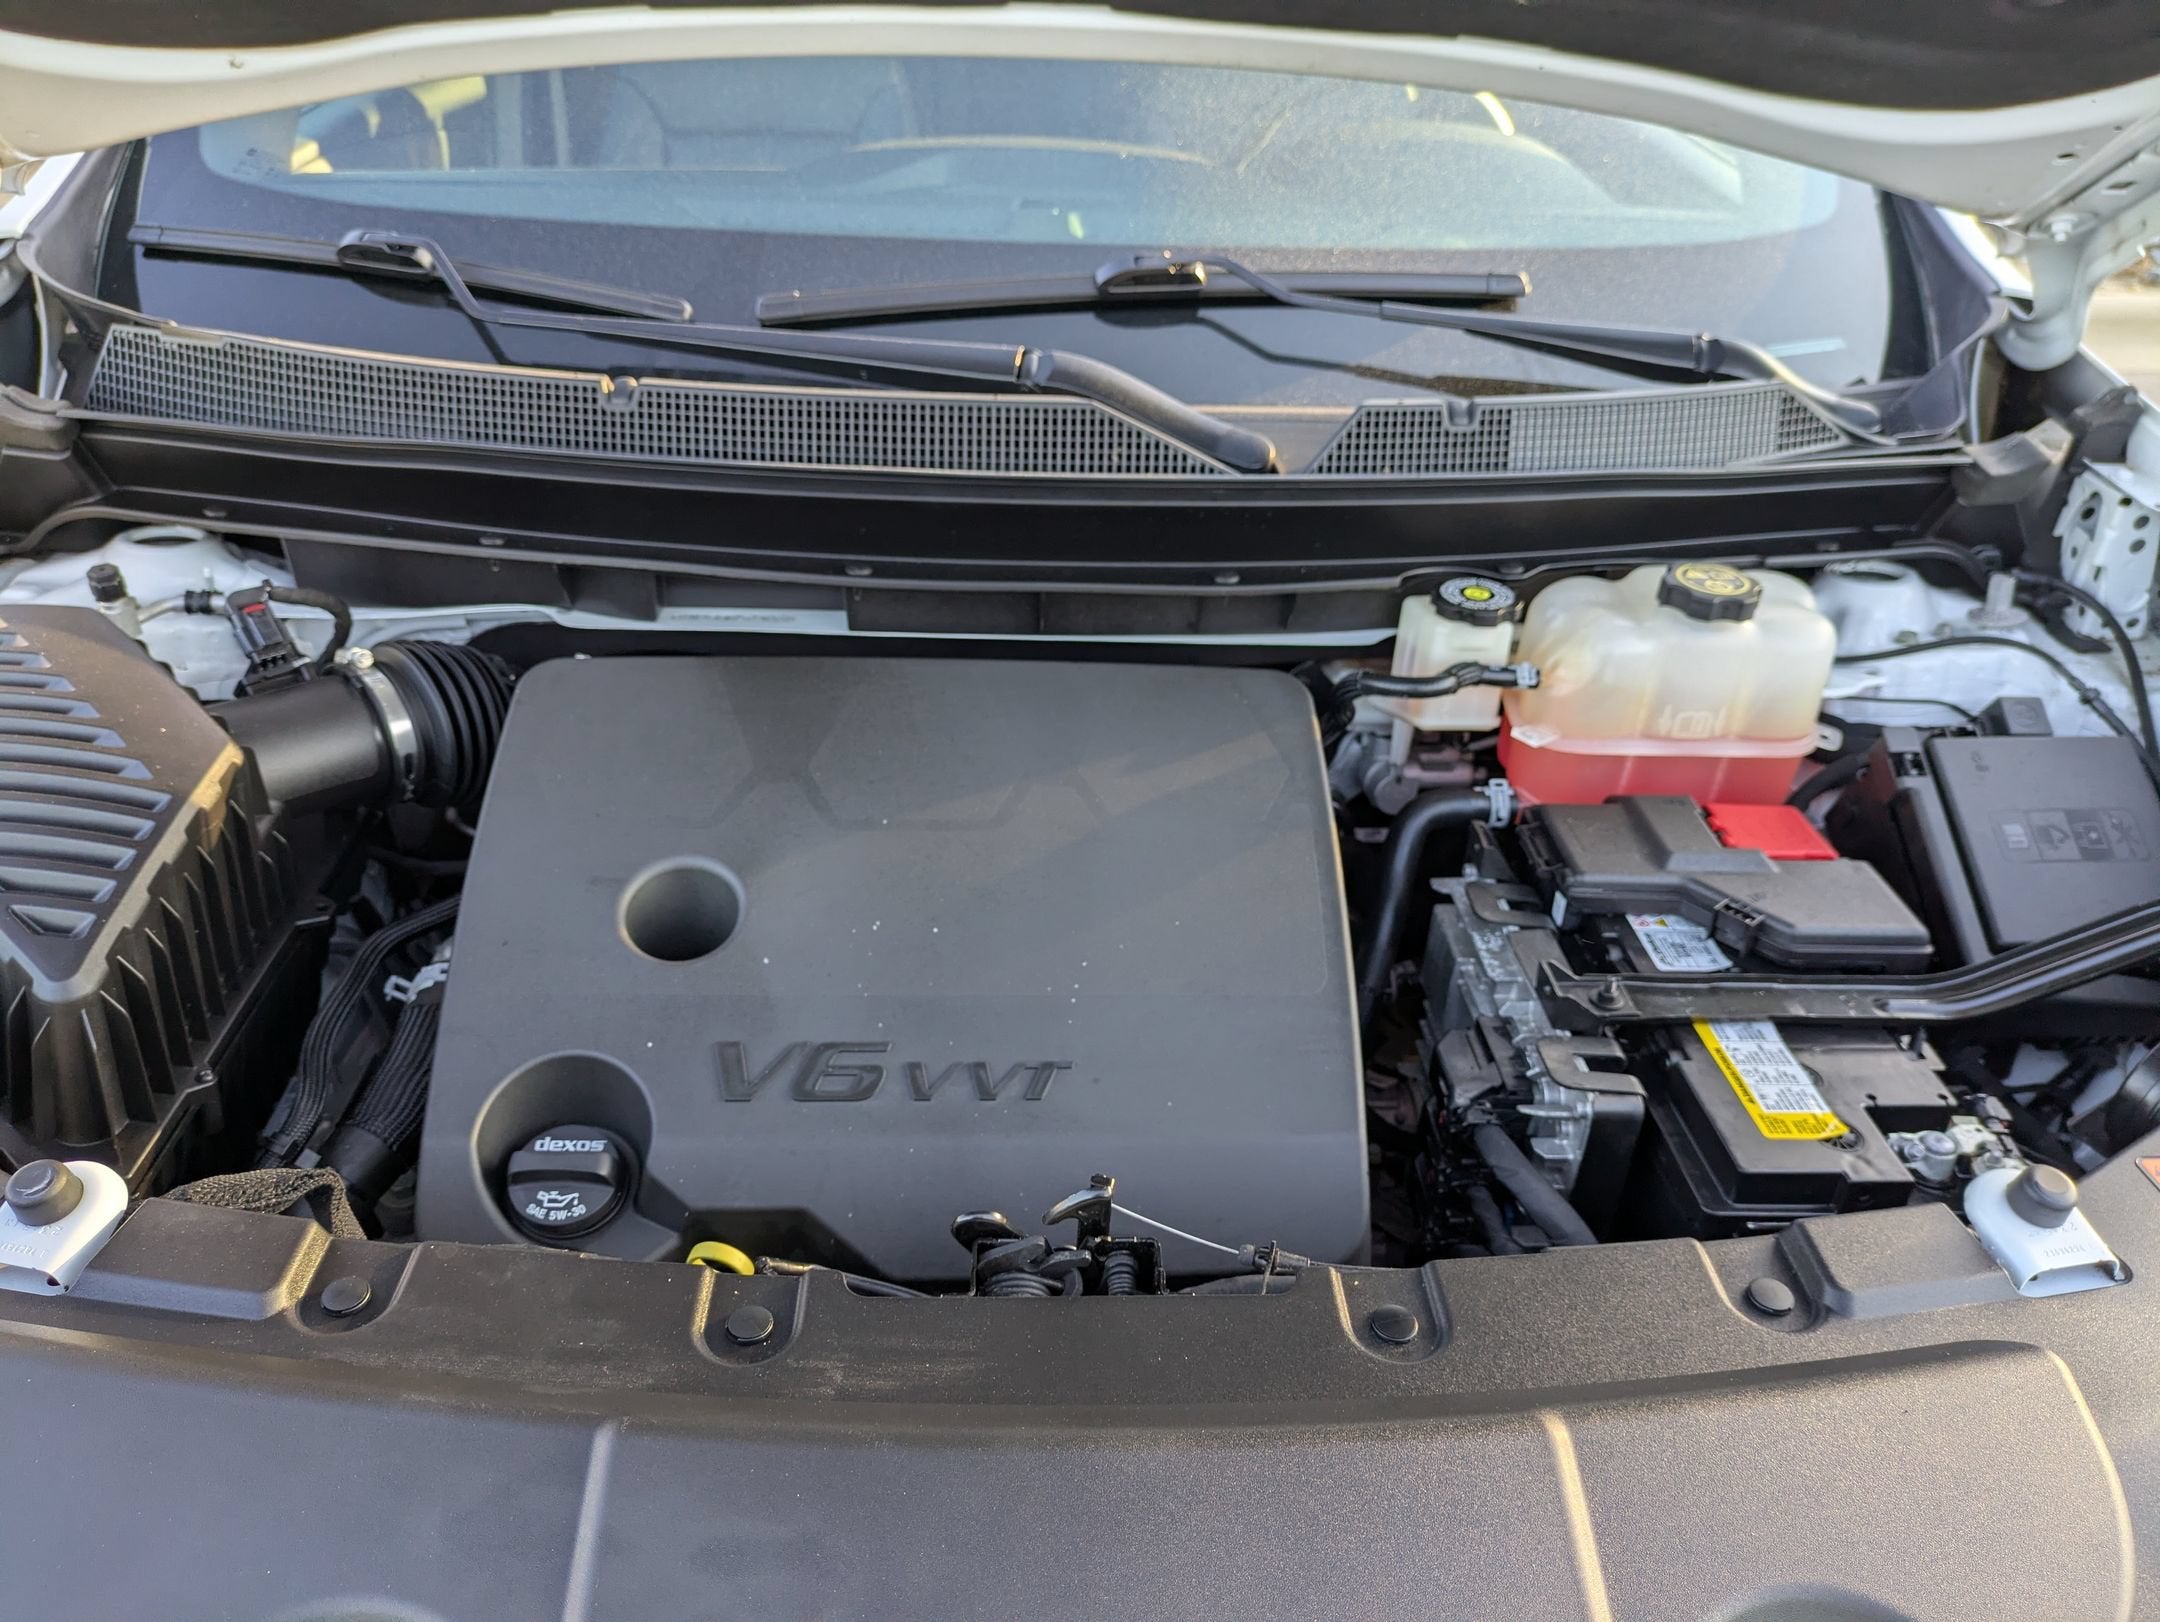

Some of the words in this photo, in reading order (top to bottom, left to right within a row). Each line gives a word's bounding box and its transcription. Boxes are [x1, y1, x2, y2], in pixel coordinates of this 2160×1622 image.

[715, 1041, 892, 1102] V6
[905, 1061, 1073, 1101] VVT
[534, 1137, 608, 1152] dexos
[526, 1204, 547, 1219] SAE
[549, 1205, 586, 1220] 5W-30
